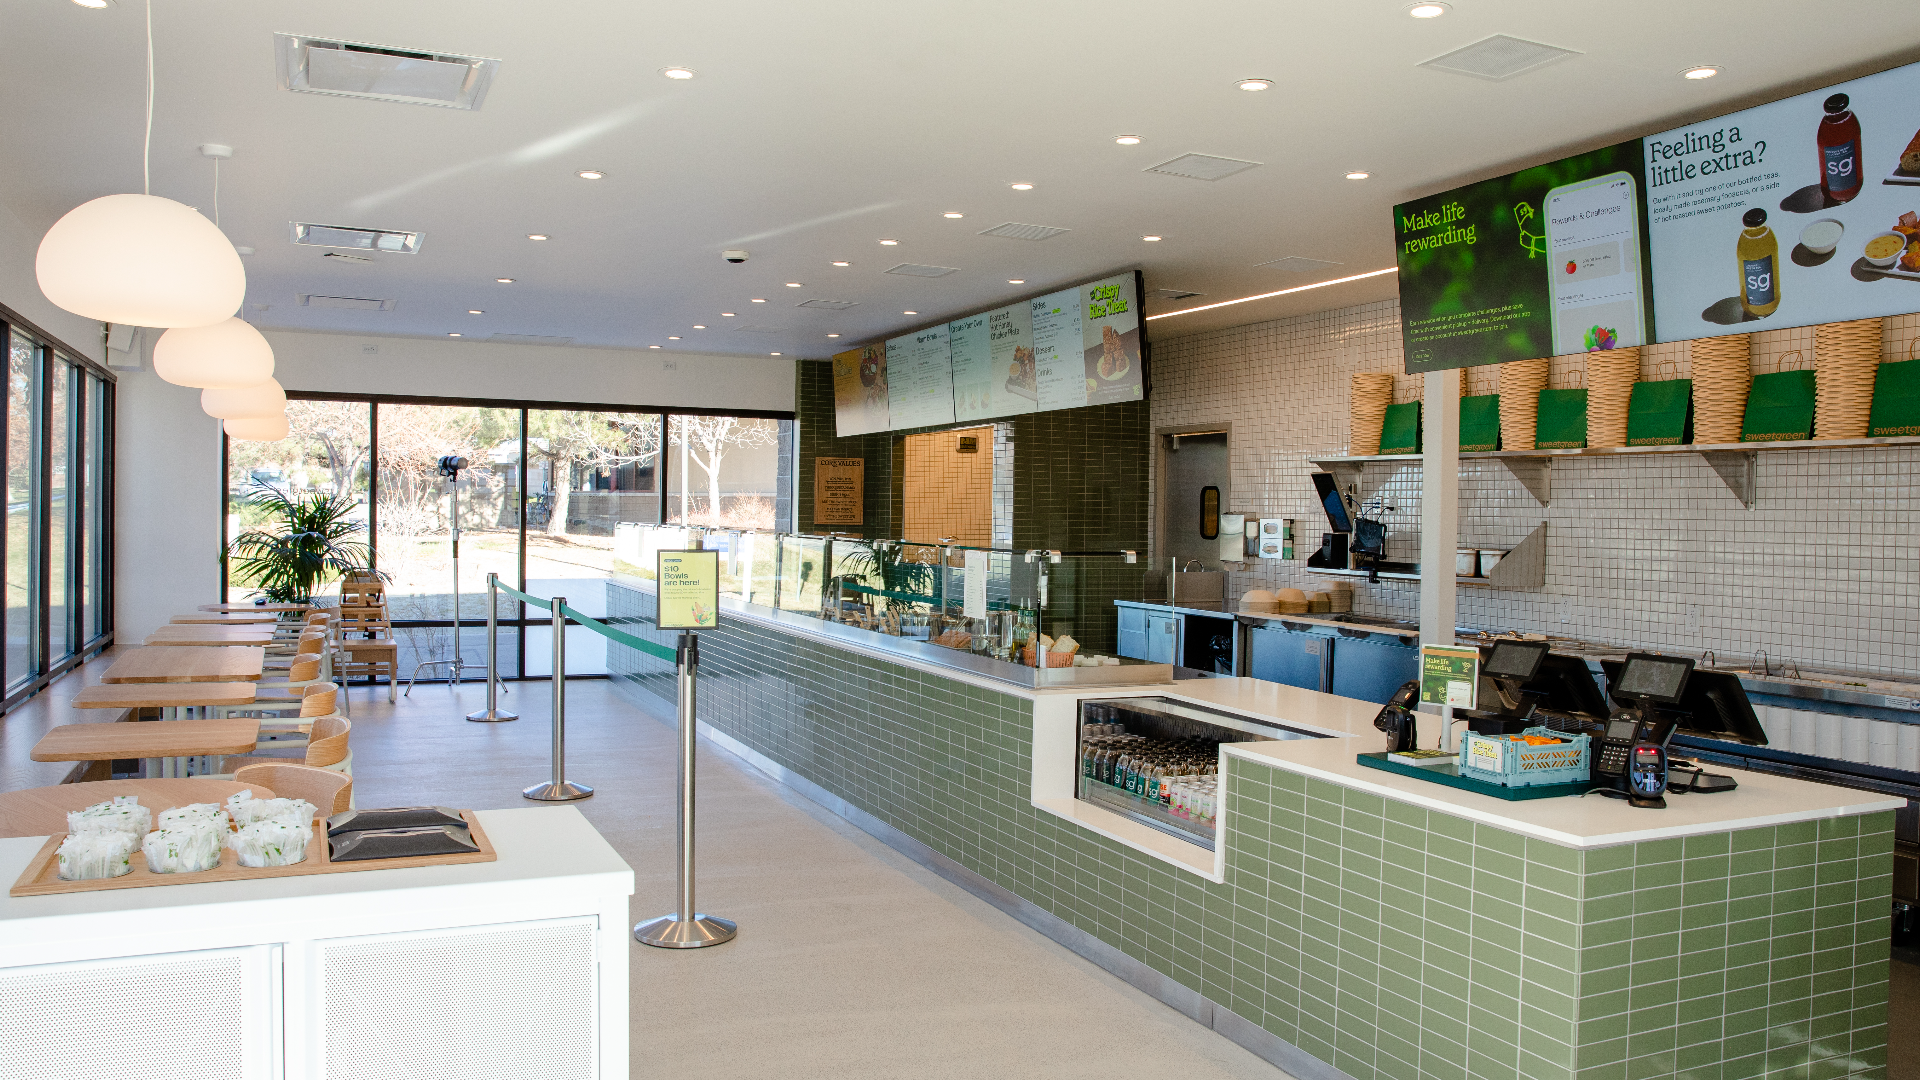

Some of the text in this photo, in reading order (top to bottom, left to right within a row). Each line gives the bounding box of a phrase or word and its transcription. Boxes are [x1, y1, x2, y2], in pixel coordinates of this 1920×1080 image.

[1650, 127, 1742, 163] Feeling a
[1651, 140, 1766, 187] little extra?
[1828, 156, 1853, 177] sg
[1403, 202, 1465, 233] Make life
[1405, 224, 1476, 254] rewarding
[1748, 272, 1771, 292] sg
[1094, 284, 1120, 300] Crispy
[1089, 303, 1106, 320] Rice
[1106, 298, 1128, 315] Treat
[1538, 440, 1582, 449] sweetgreen
[1630, 436, 1680, 446] sweetgreen
[1744, 431, 1806, 442] sweetgreen
[1381, 446, 1415, 455] sweetgreen
[1459, 444, 1495, 452] weetgreen
[664, 572, 688, 580] Bowls
[1126, 780, 1136, 790] sg
